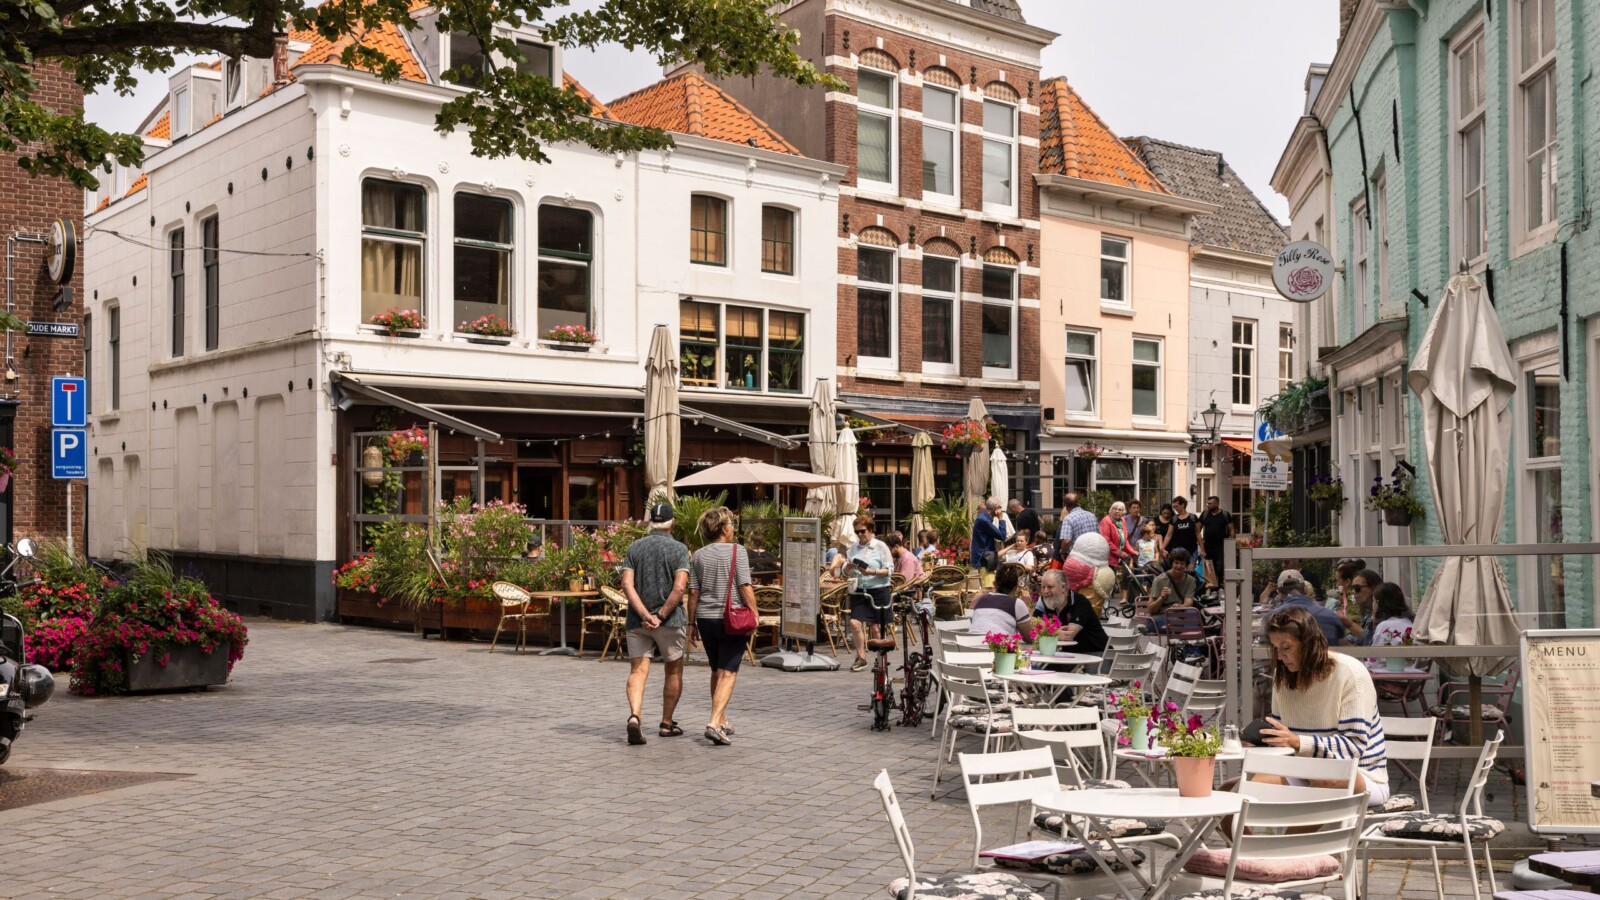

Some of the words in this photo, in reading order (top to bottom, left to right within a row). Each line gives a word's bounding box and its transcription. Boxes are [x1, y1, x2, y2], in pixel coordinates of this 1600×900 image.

[1303, 248, 1330, 265] Rose
[50, 325, 77, 334] MARKT
[60, 433, 79, 458] P
[1543, 646, 1586, 657] MENU
